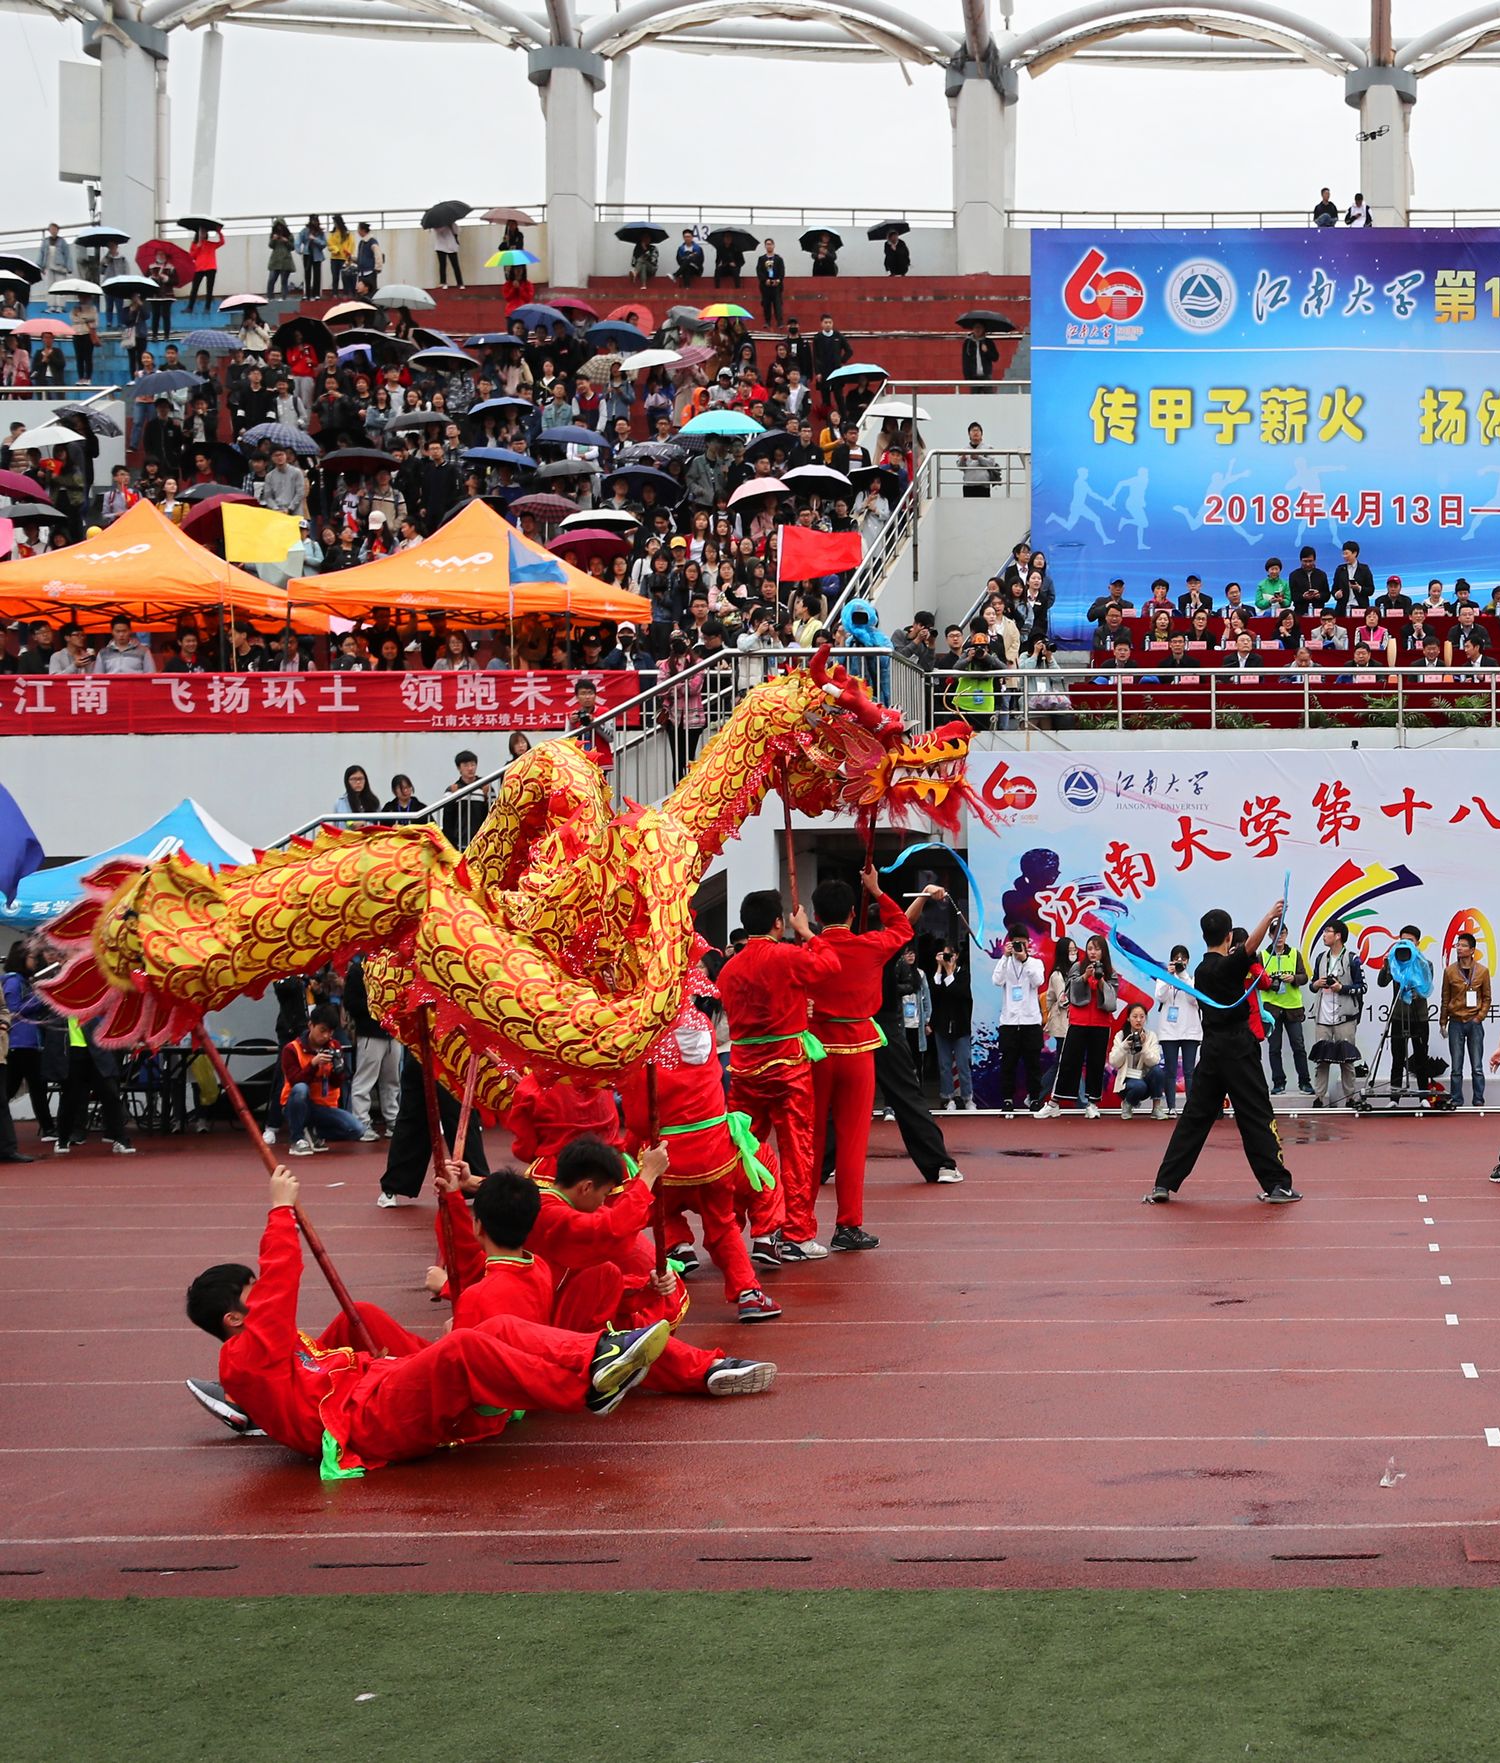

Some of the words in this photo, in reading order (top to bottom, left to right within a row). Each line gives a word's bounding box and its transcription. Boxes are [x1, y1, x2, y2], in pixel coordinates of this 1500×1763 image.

[1253, 269, 1426, 321] 江南大学
[1089, 386, 1367, 446] 传甲子薪火
[152, 675, 360, 714] 飞扬环土
[1116, 769, 1209, 797] 江南大学
[1161, 803, 1209, 811] UNIVERSITY
